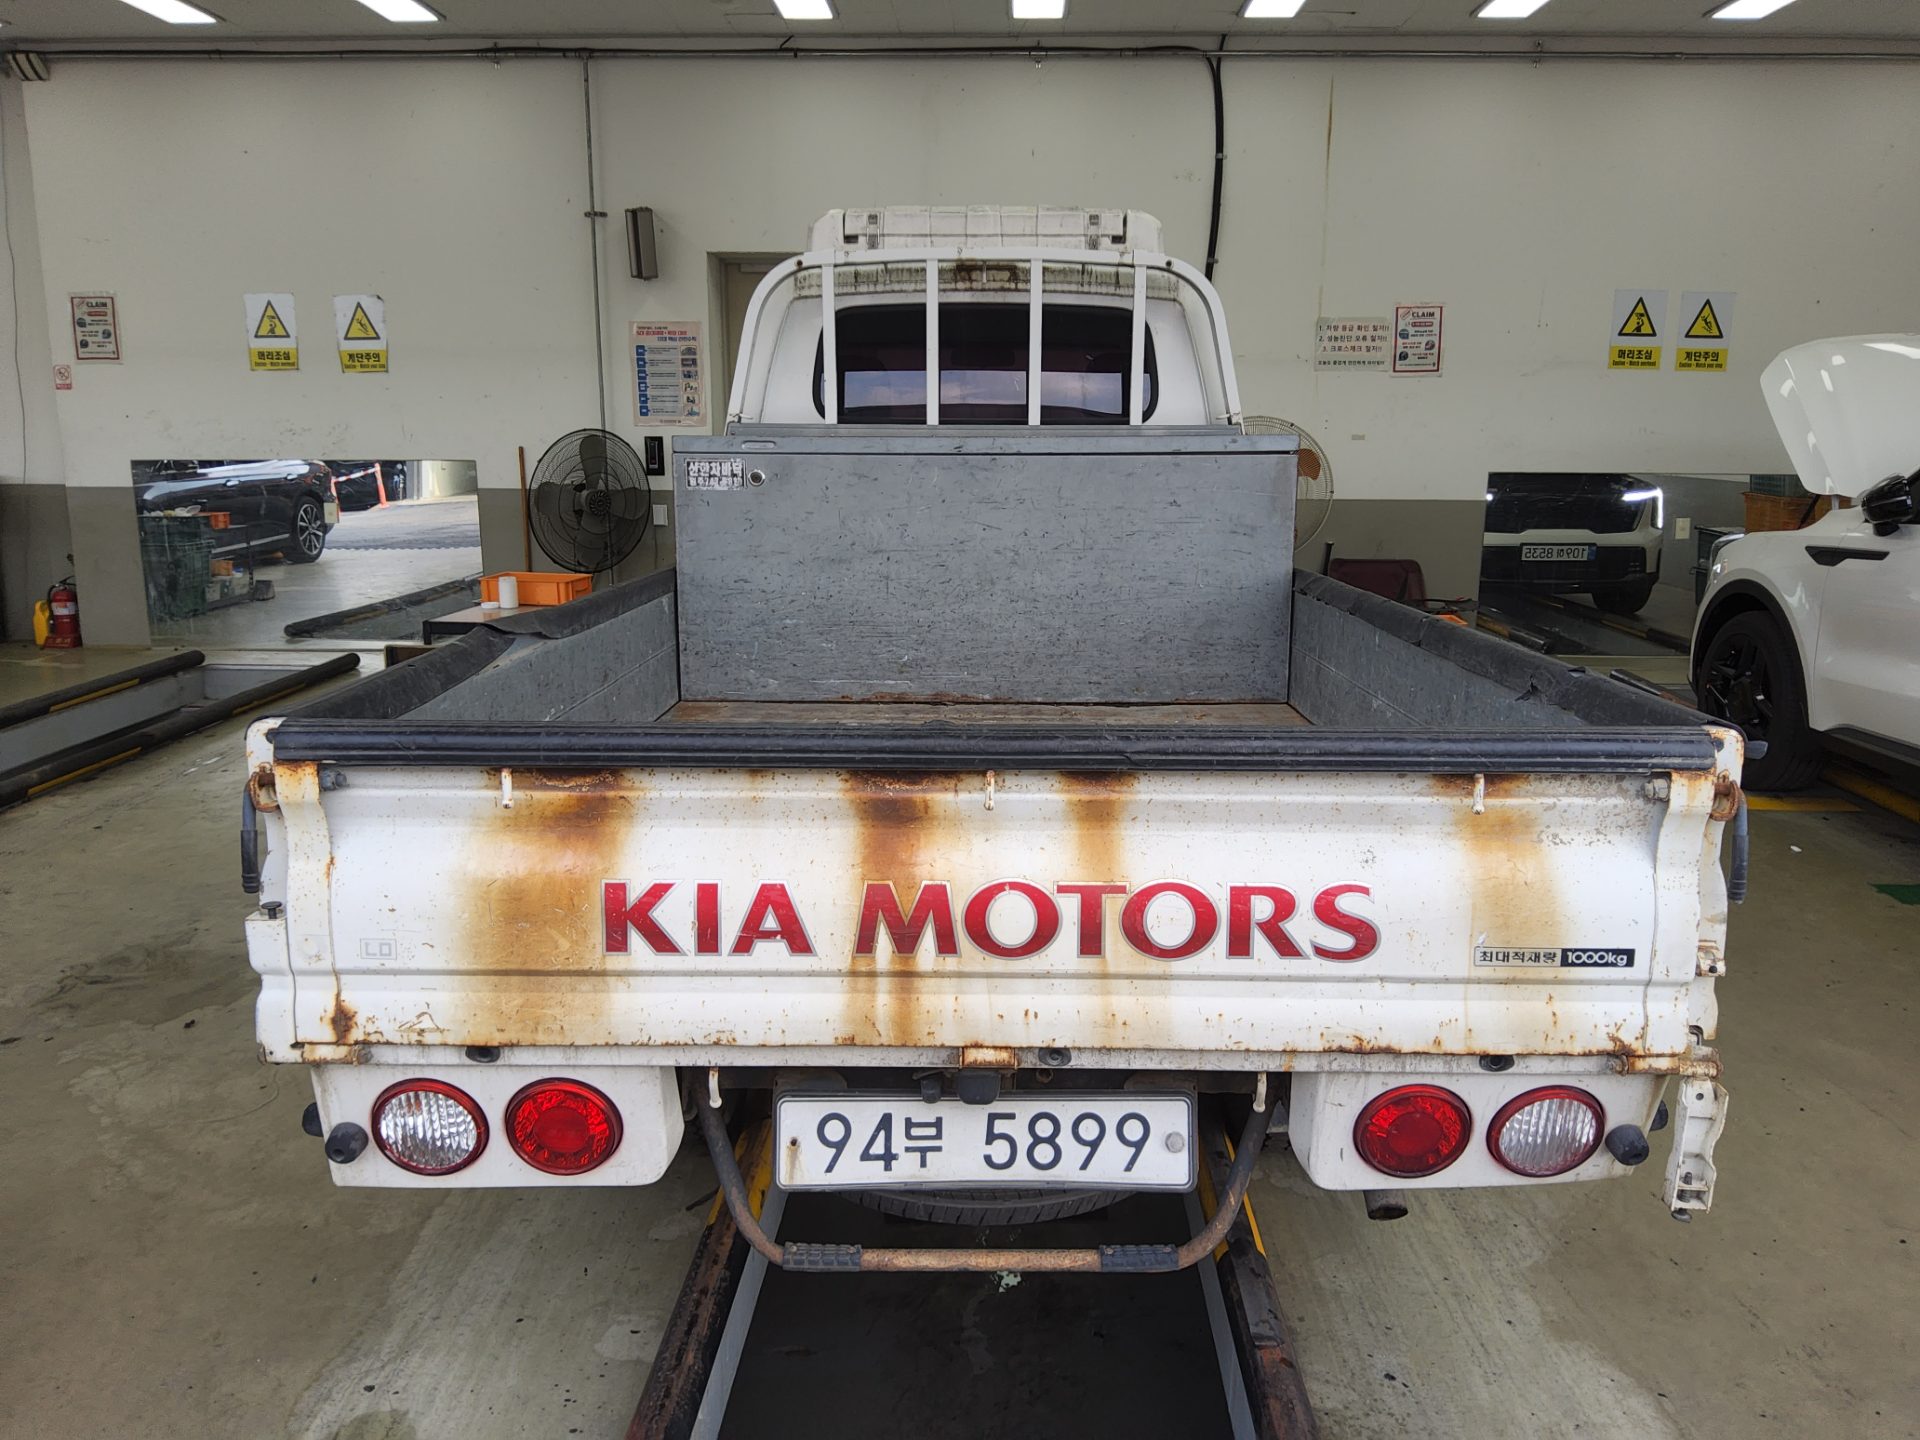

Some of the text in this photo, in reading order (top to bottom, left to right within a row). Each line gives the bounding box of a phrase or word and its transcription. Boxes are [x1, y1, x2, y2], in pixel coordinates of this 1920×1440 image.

[257, 351, 291, 361] 머리조심
[346, 352, 381, 363] 계단주의
[1617, 349, 1653, 360] 머리조심
[1684, 351, 1720, 362] 계단주의
[601, 878, 1382, 962] KIA MOTORS
[1479, 951, 1628, 966] 최대적재량 1000kg
[816, 1110, 1152, 1174] 94부 5899
